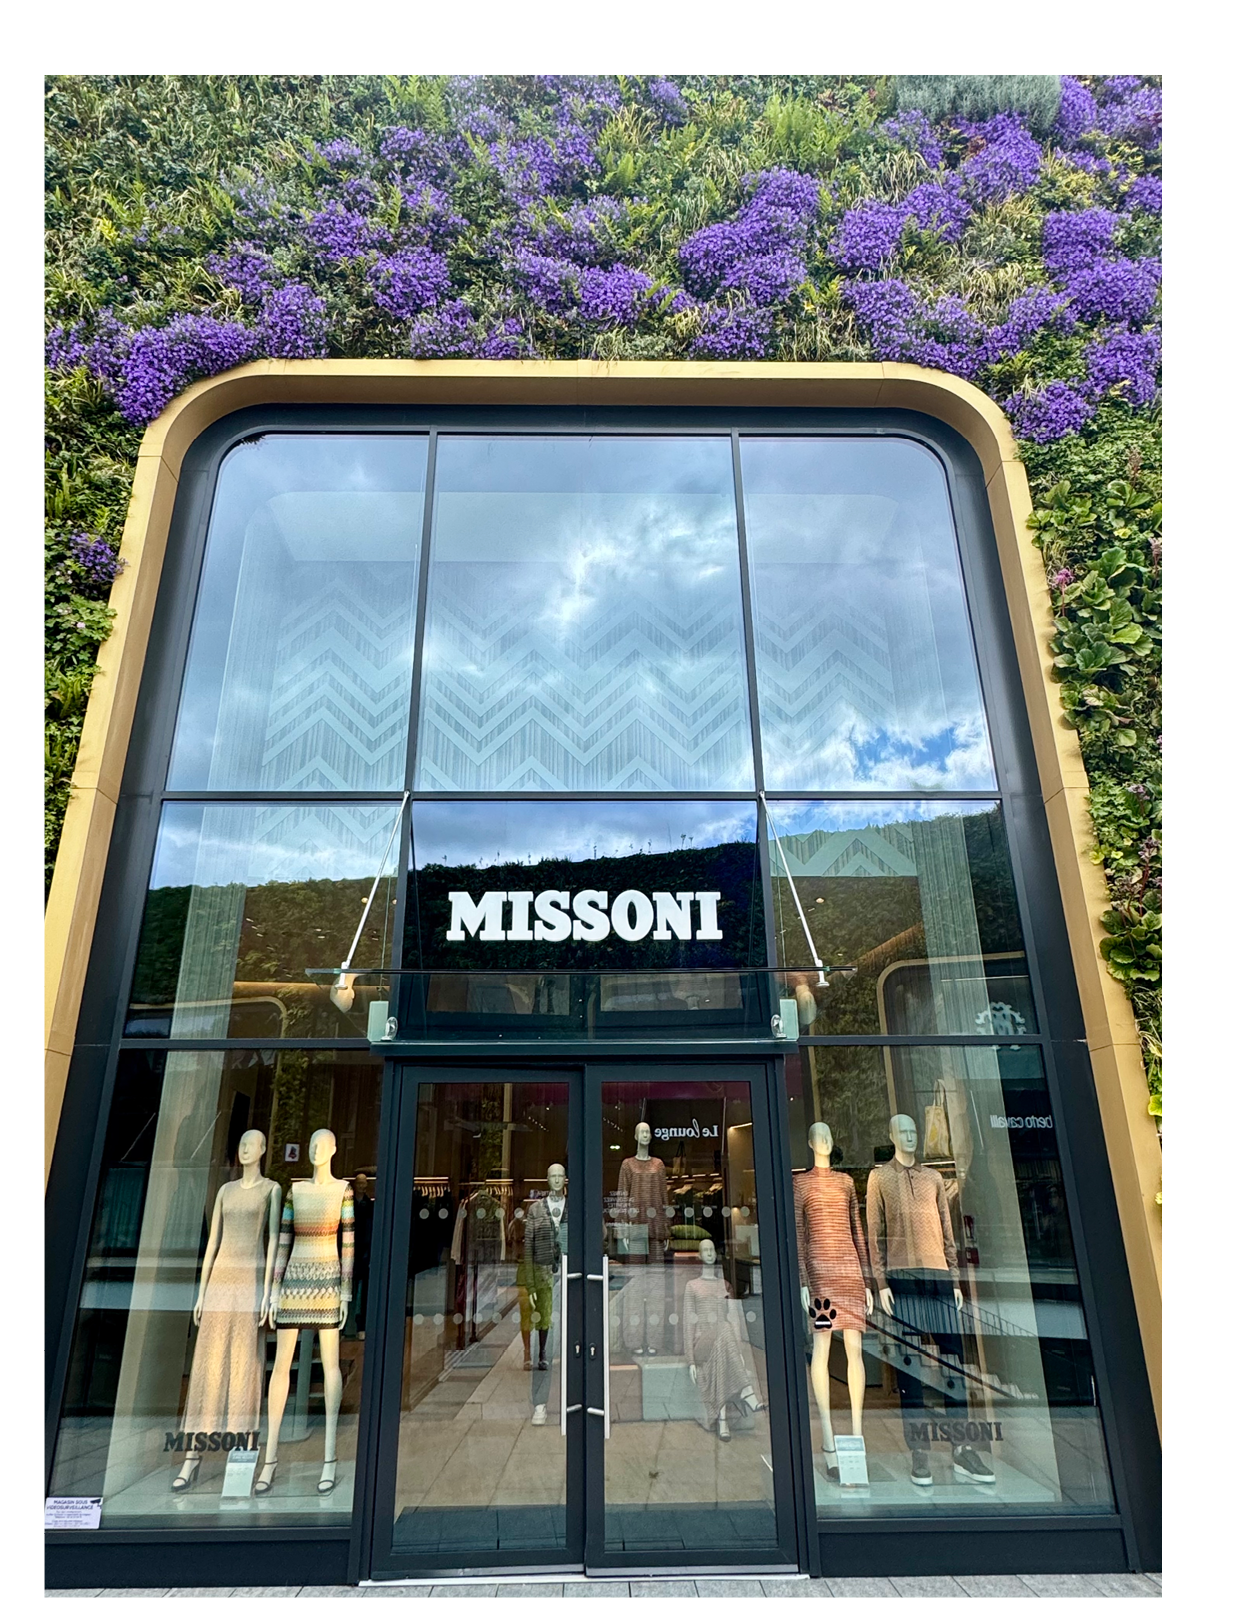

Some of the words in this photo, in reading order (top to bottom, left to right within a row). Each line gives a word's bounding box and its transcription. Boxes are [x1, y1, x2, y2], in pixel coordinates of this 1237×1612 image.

[447, 890, 722, 941] MISSONI
[163, 1431, 261, 1452] MISSONI
[909, 1421, 1004, 1442] MISSONI
